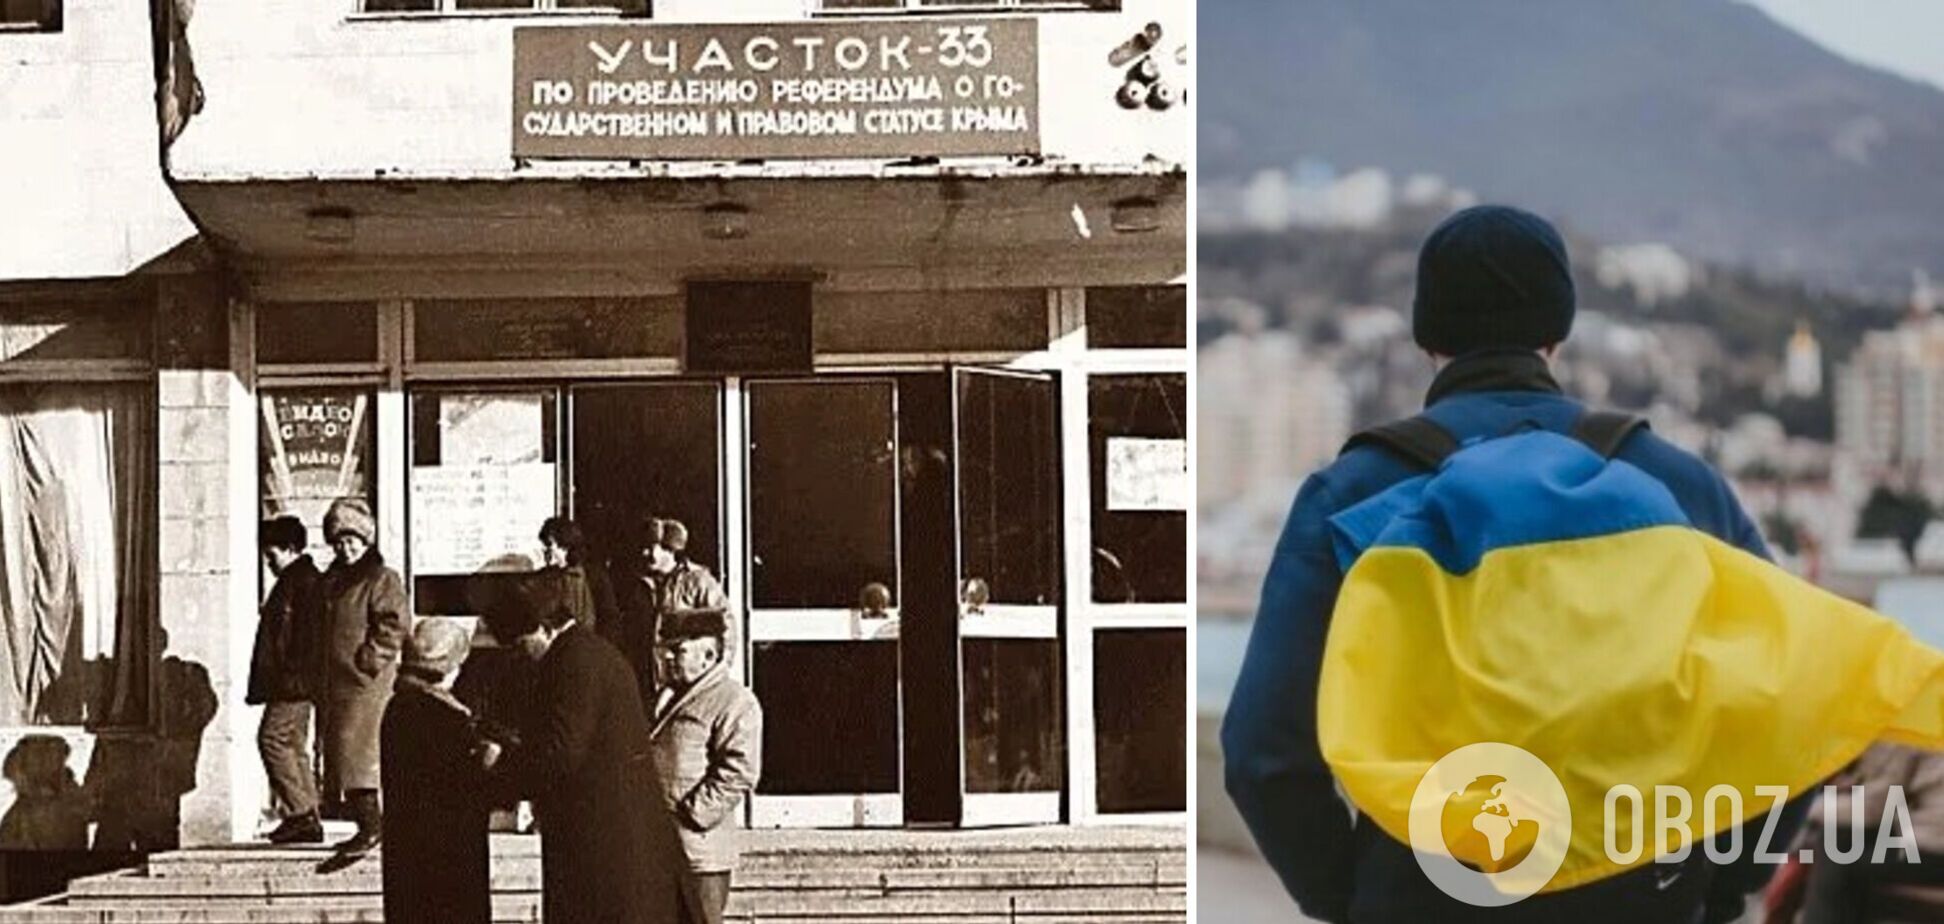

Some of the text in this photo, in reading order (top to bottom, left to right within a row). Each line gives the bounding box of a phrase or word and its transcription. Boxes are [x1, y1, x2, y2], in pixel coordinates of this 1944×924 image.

[588, 25, 993, 73] УЧАСТОК-33
[533, 75, 1024, 105] ПО ПРОВЕДЕНИЮ РЕФЕРЕНДУМА О ГО-
[523, 106, 1029, 136] СУДАРСТВЕННОМ И ПРАВОВОМ СТАТУСЕ КРЫМА
